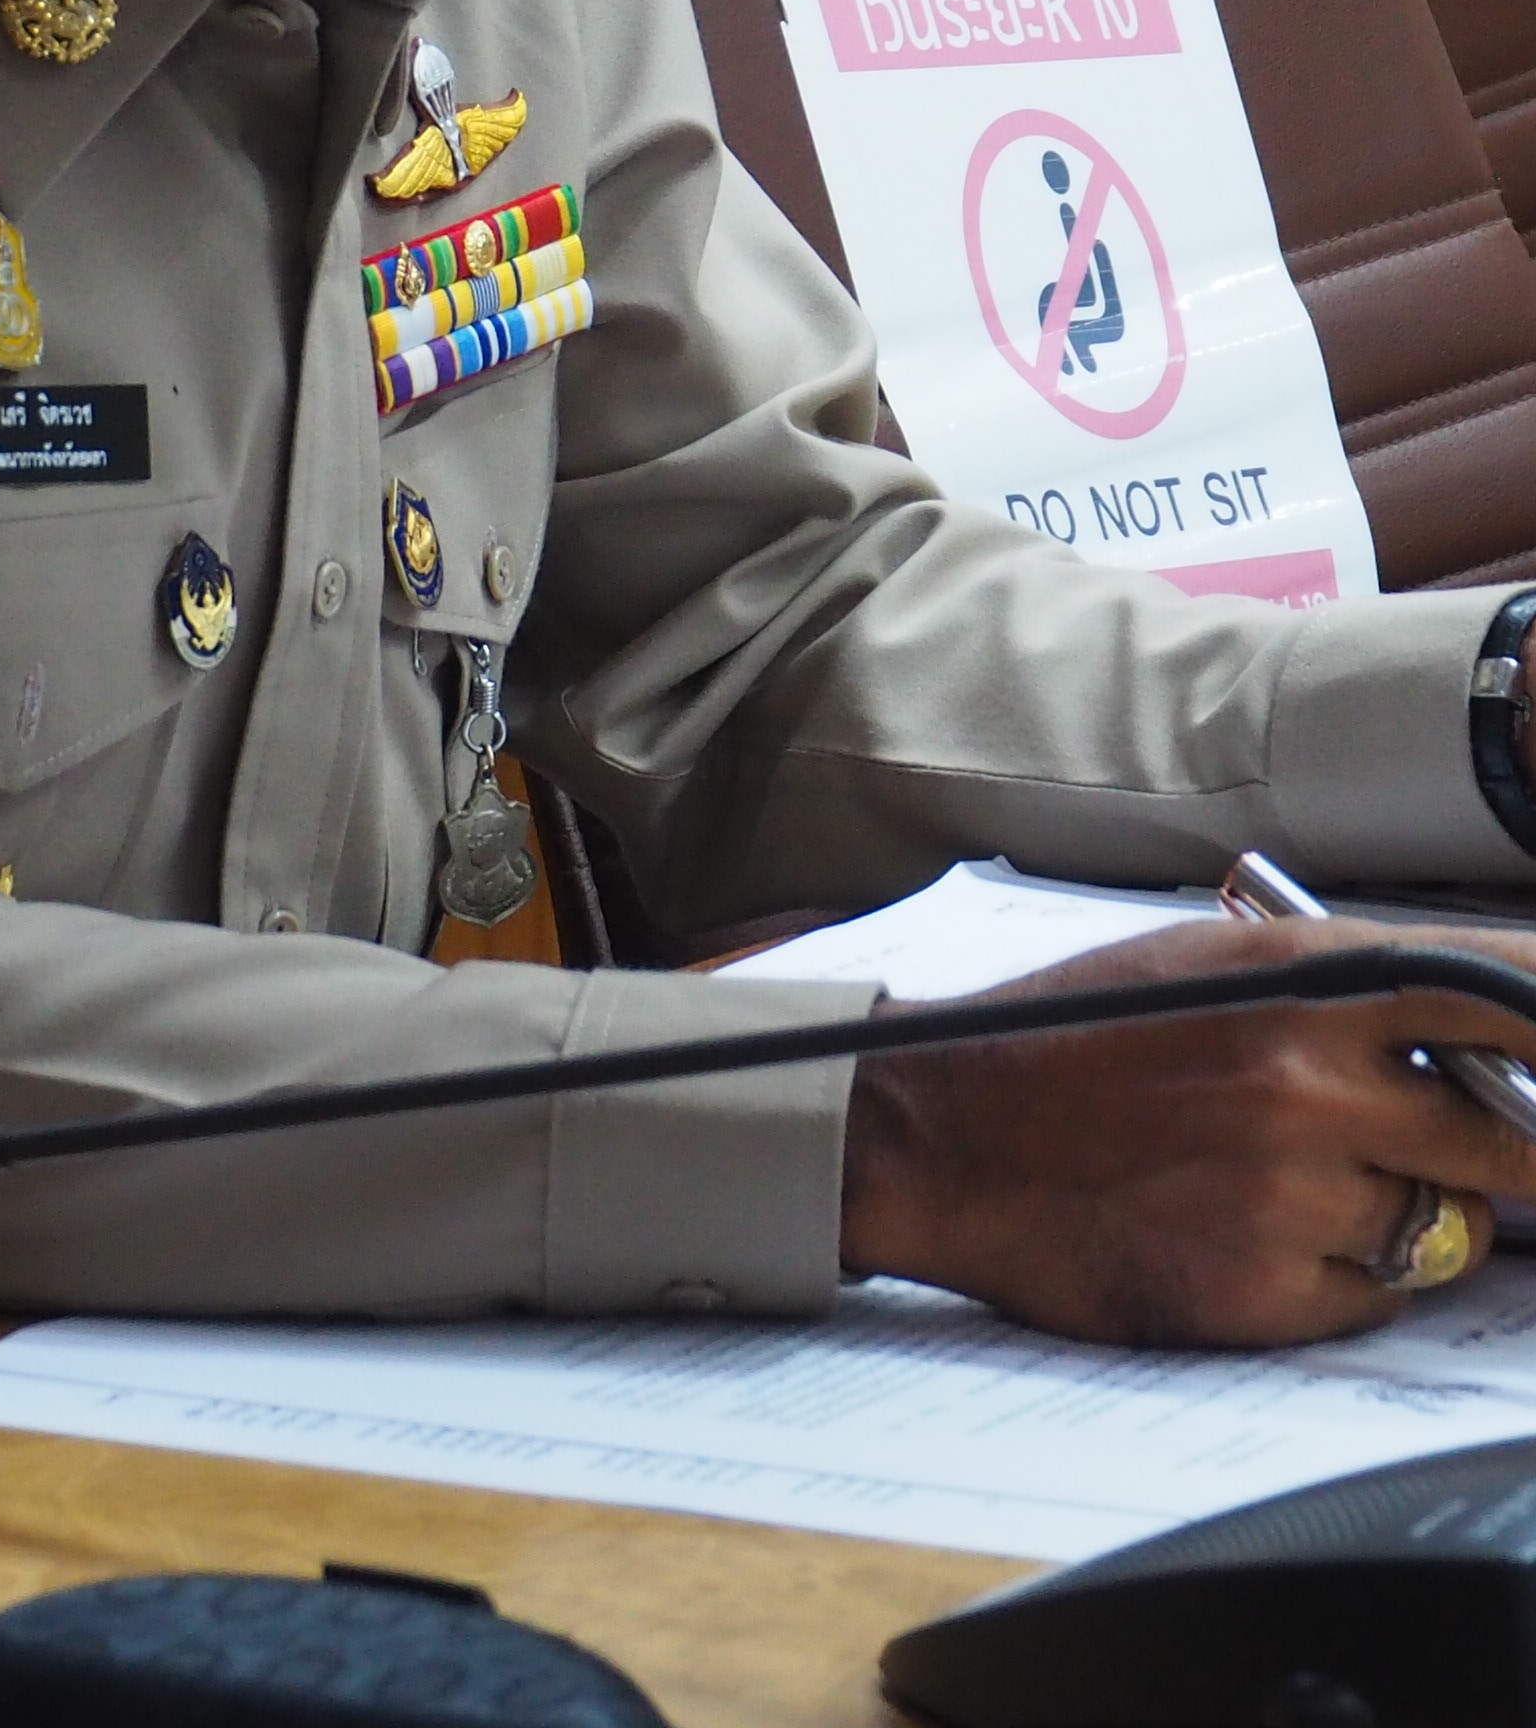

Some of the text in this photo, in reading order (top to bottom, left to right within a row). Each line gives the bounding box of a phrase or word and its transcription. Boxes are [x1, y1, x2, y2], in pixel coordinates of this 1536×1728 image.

[1005, 467, 1270, 544] DO NOT SIT
